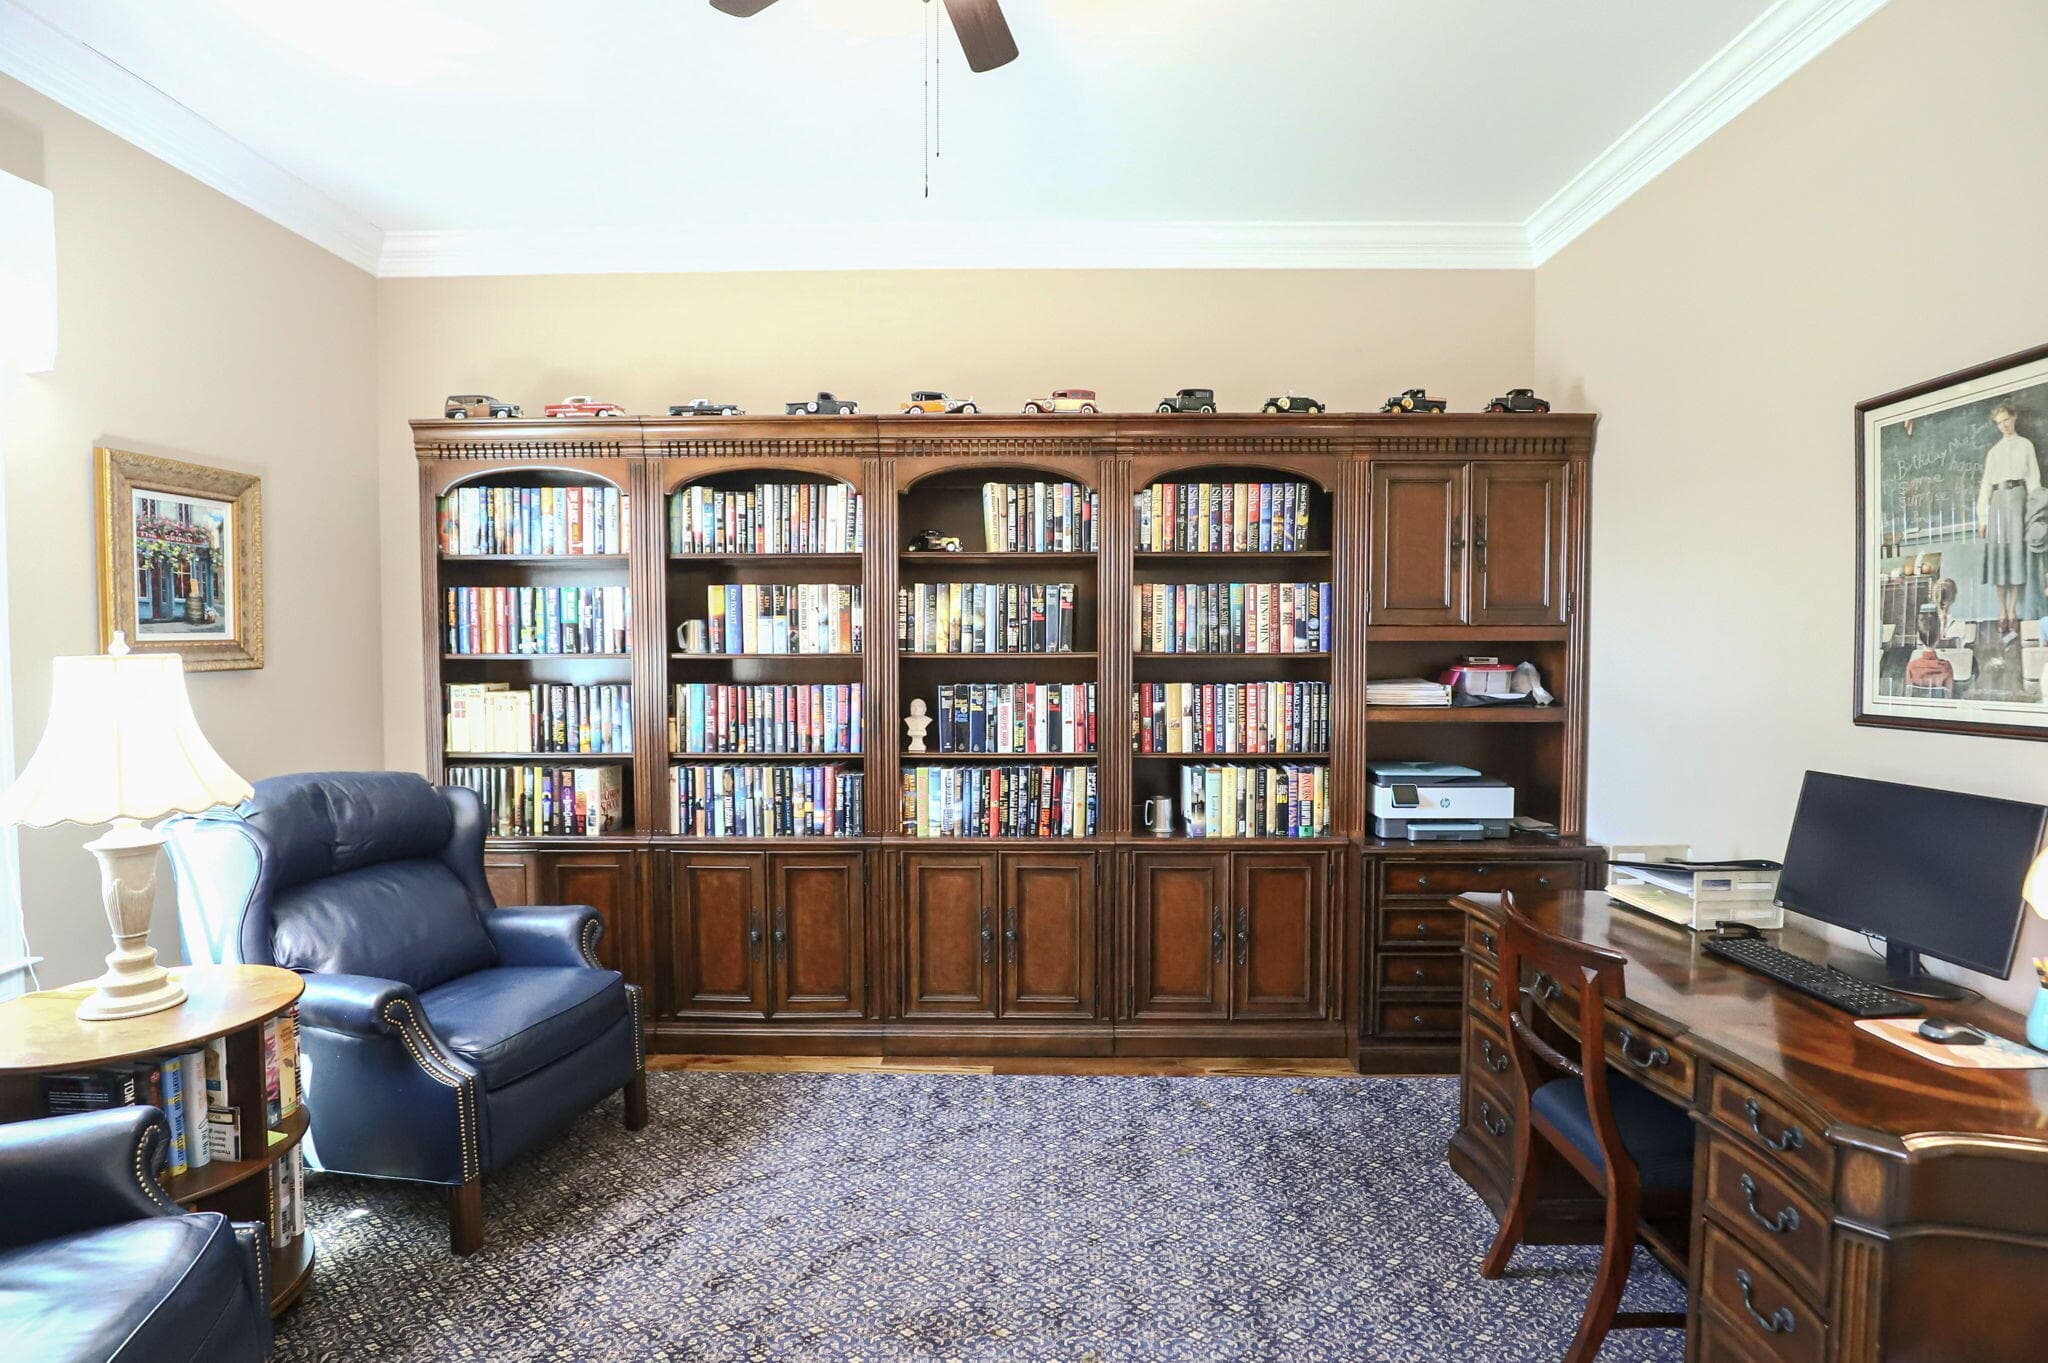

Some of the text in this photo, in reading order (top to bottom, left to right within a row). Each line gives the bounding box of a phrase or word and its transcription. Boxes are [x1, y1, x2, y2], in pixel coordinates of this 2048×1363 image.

[1190, 489, 1198, 510] Silva
[1212, 489, 1221, 511] Silva
[1224, 489, 1233, 511] Silva
[1250, 489, 1259, 512] Silva
[1262, 489, 1270, 509] Silva
[1274, 489, 1283, 511] Silva
[1286, 488, 1294, 507] Silva
[847, 499, 856, 544] KEN FOLLETT
[1221, 588, 1229, 627] WILBUR SMITH
[1260, 594, 1269, 614] MEN
[1309, 588, 1319, 616] MONSOON
[1247, 614, 1256, 643] POWER
[1260, 623, 1269, 644] MEN
[123, 1079, 135, 1102] TOM
